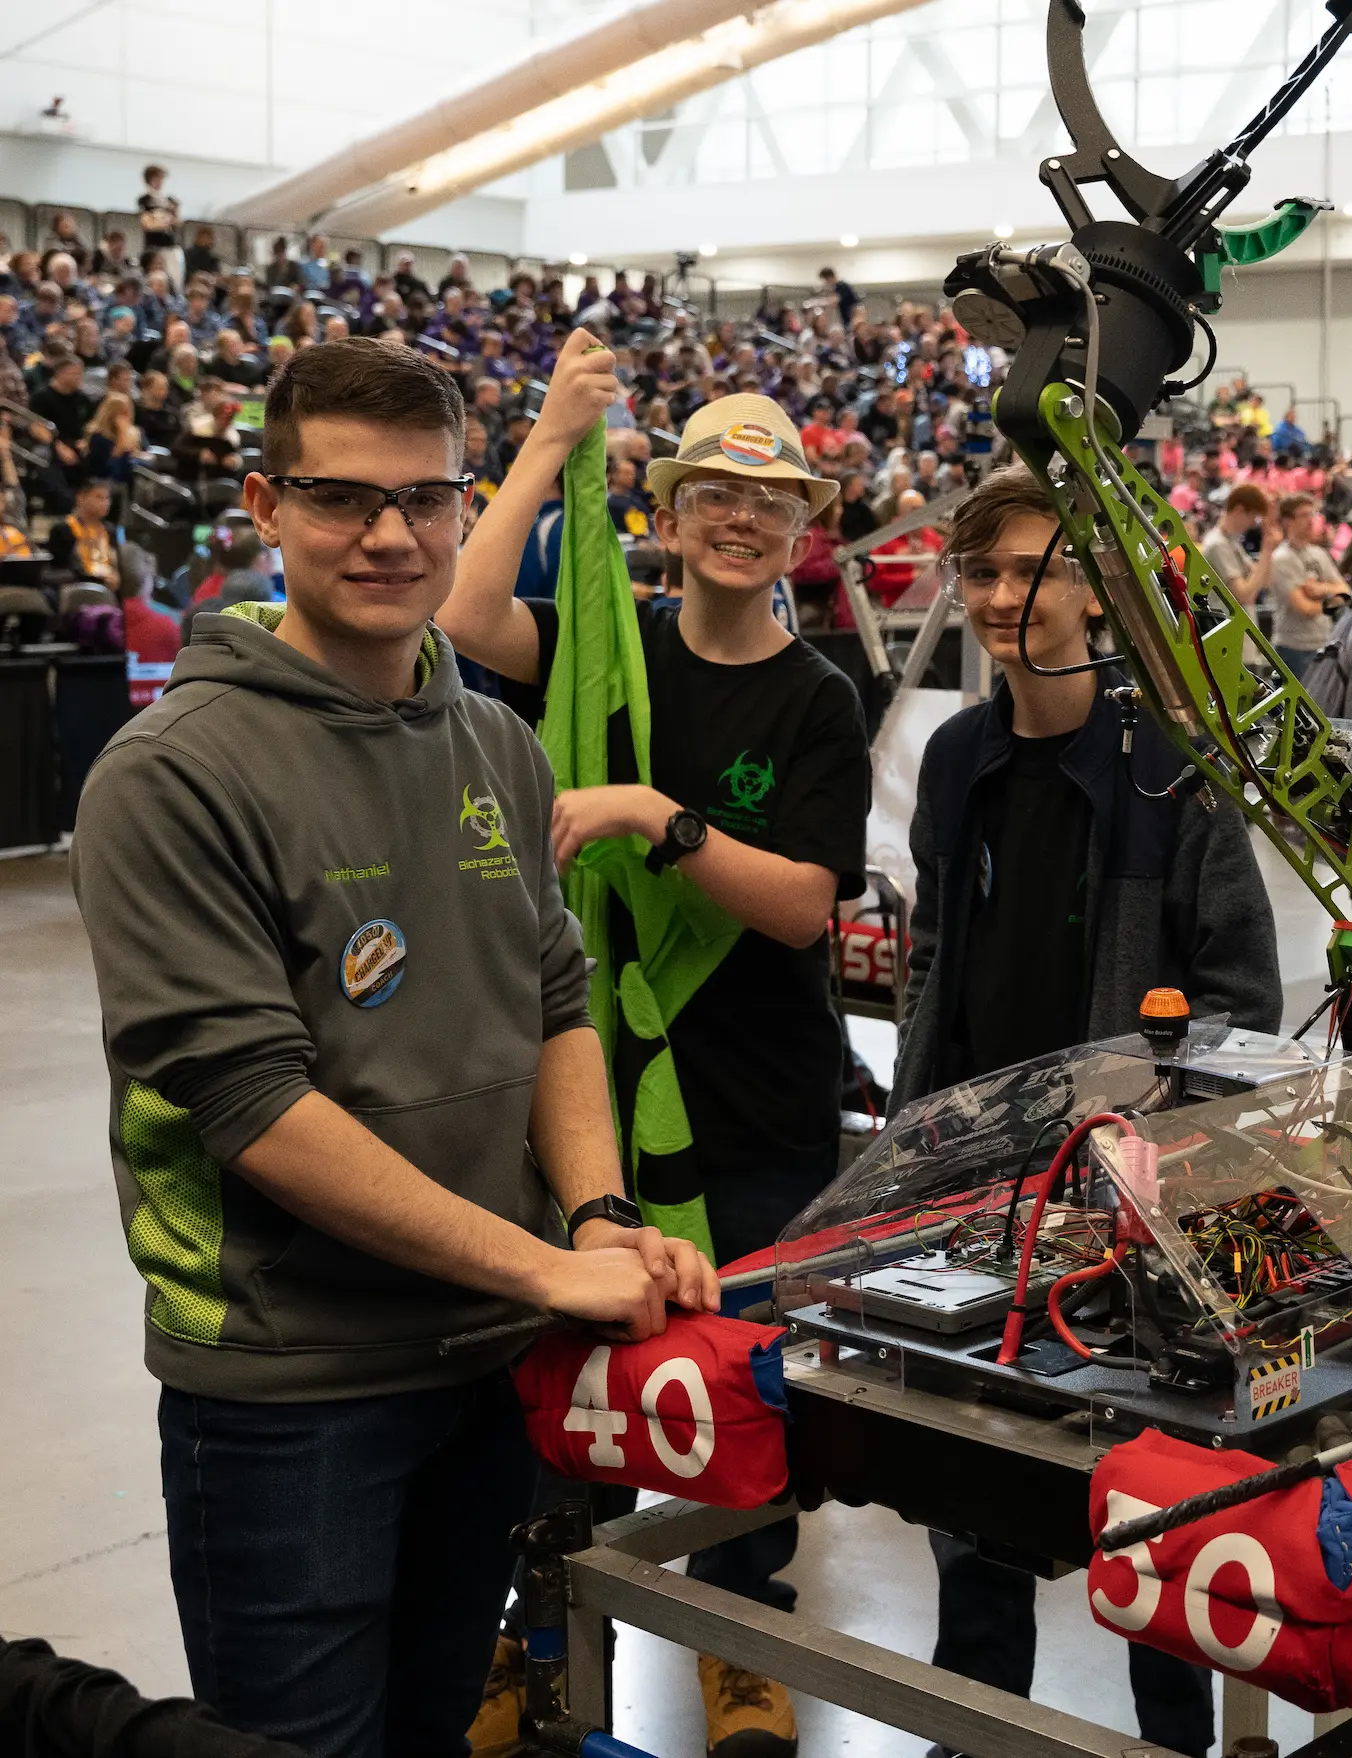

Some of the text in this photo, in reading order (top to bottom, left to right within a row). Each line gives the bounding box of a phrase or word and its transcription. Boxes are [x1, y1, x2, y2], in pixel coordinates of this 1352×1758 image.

[325, 861, 390, 883] Nathaniel
[458, 855, 511, 871] Biohazard
[481, 866, 520, 880] Robotic
[371, 970, 393, 991] COACH
[1253, 1371, 1297, 1401] BREAKER
[563, 1345, 715, 1478] 40
[1092, 1489, 1284, 1672] 50
